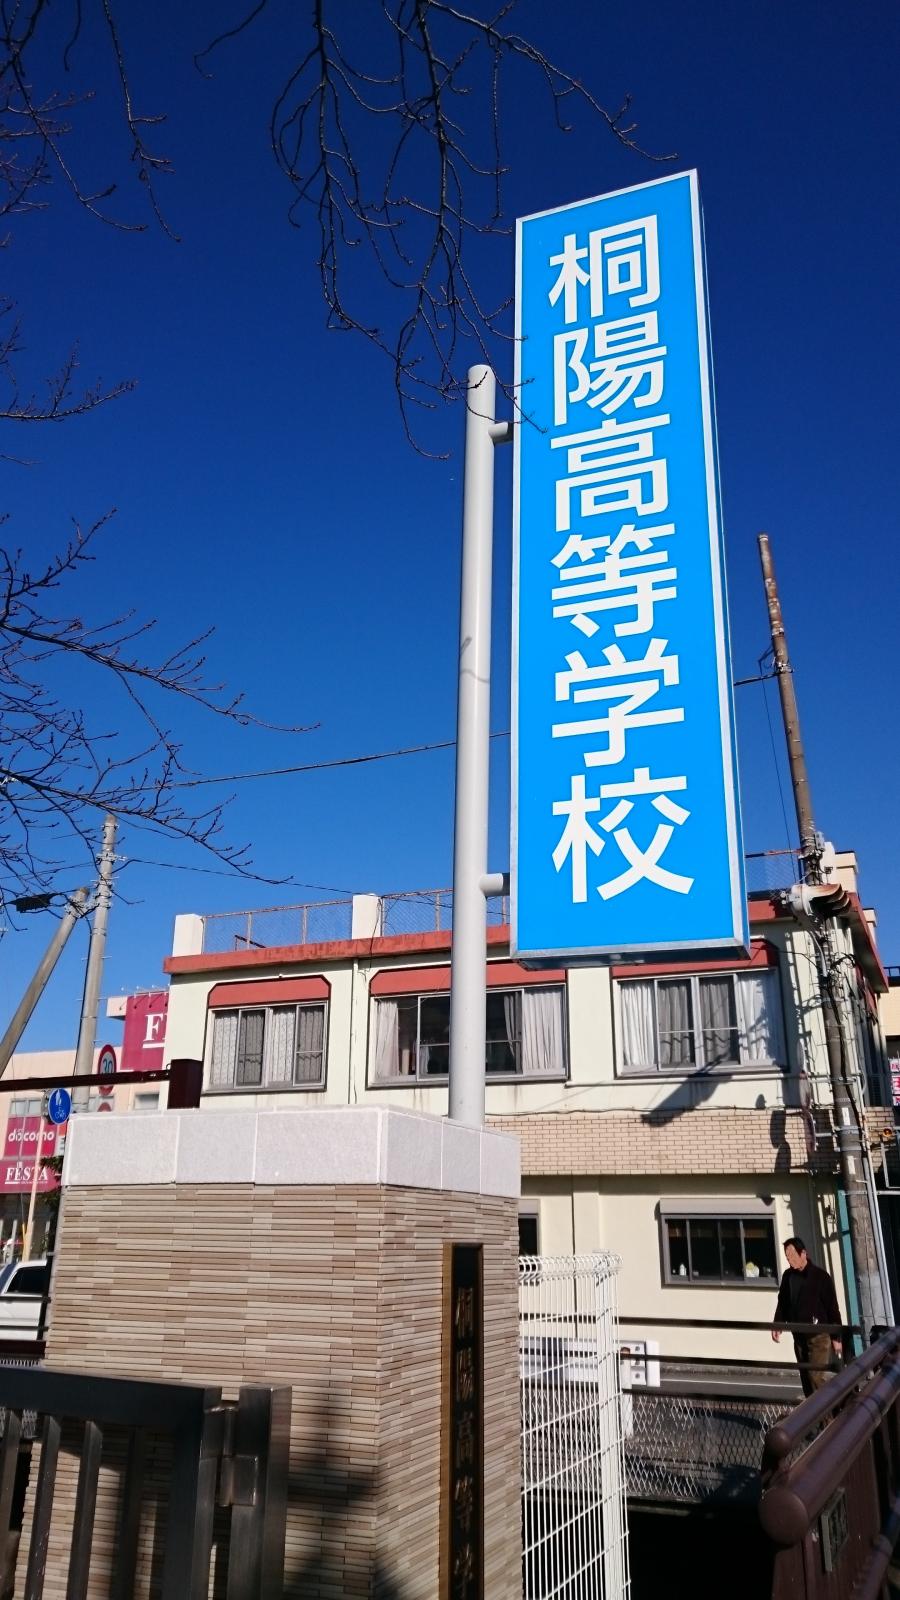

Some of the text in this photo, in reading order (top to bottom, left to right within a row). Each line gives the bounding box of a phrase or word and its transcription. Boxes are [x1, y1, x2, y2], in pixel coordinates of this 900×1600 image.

[548, 214, 694, 905] 桐陽高等学校
